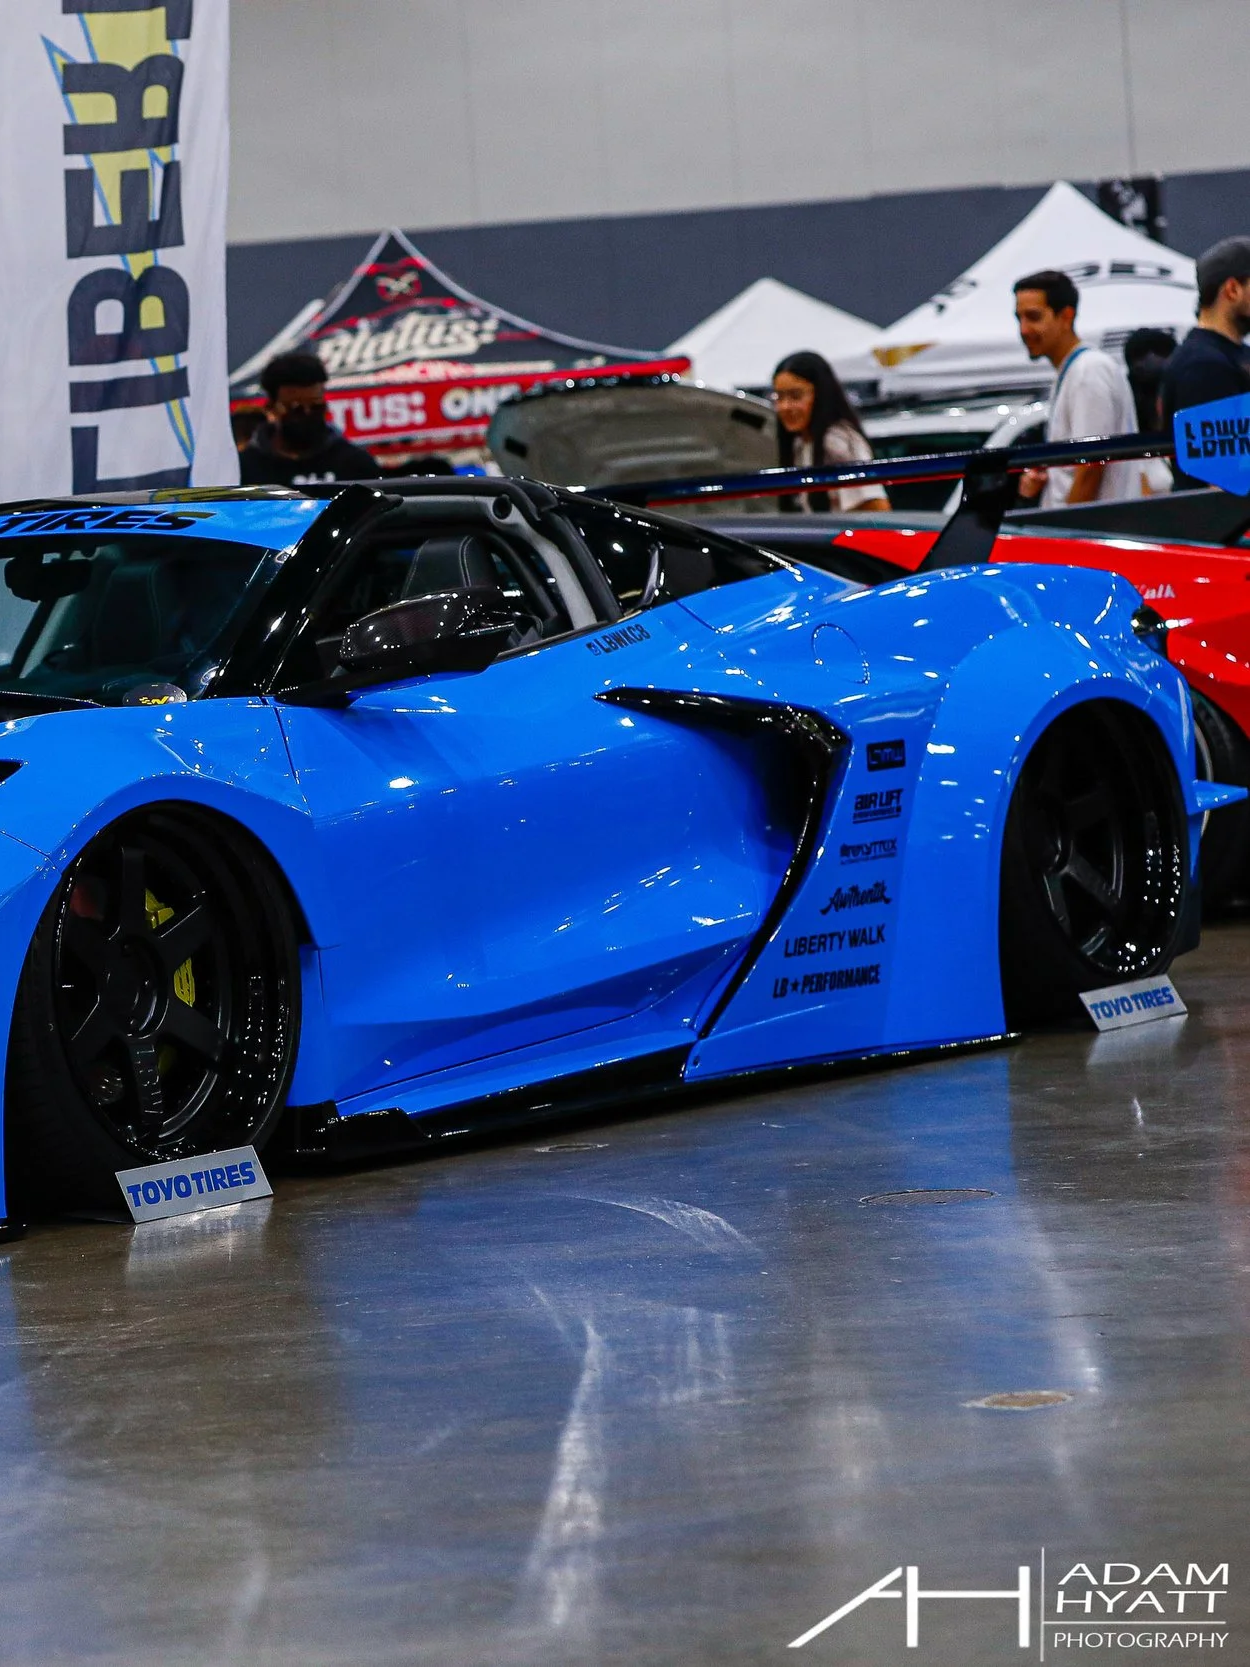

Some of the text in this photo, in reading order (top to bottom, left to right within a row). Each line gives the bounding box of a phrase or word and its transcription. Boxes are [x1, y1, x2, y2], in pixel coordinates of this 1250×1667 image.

[328, 391, 427, 431] TUS:
[879, 788, 904, 807] LIFT
[784, 923, 886, 958] LIBERTY WALK
[773, 964, 881, 999] LB PERFORMANCE
